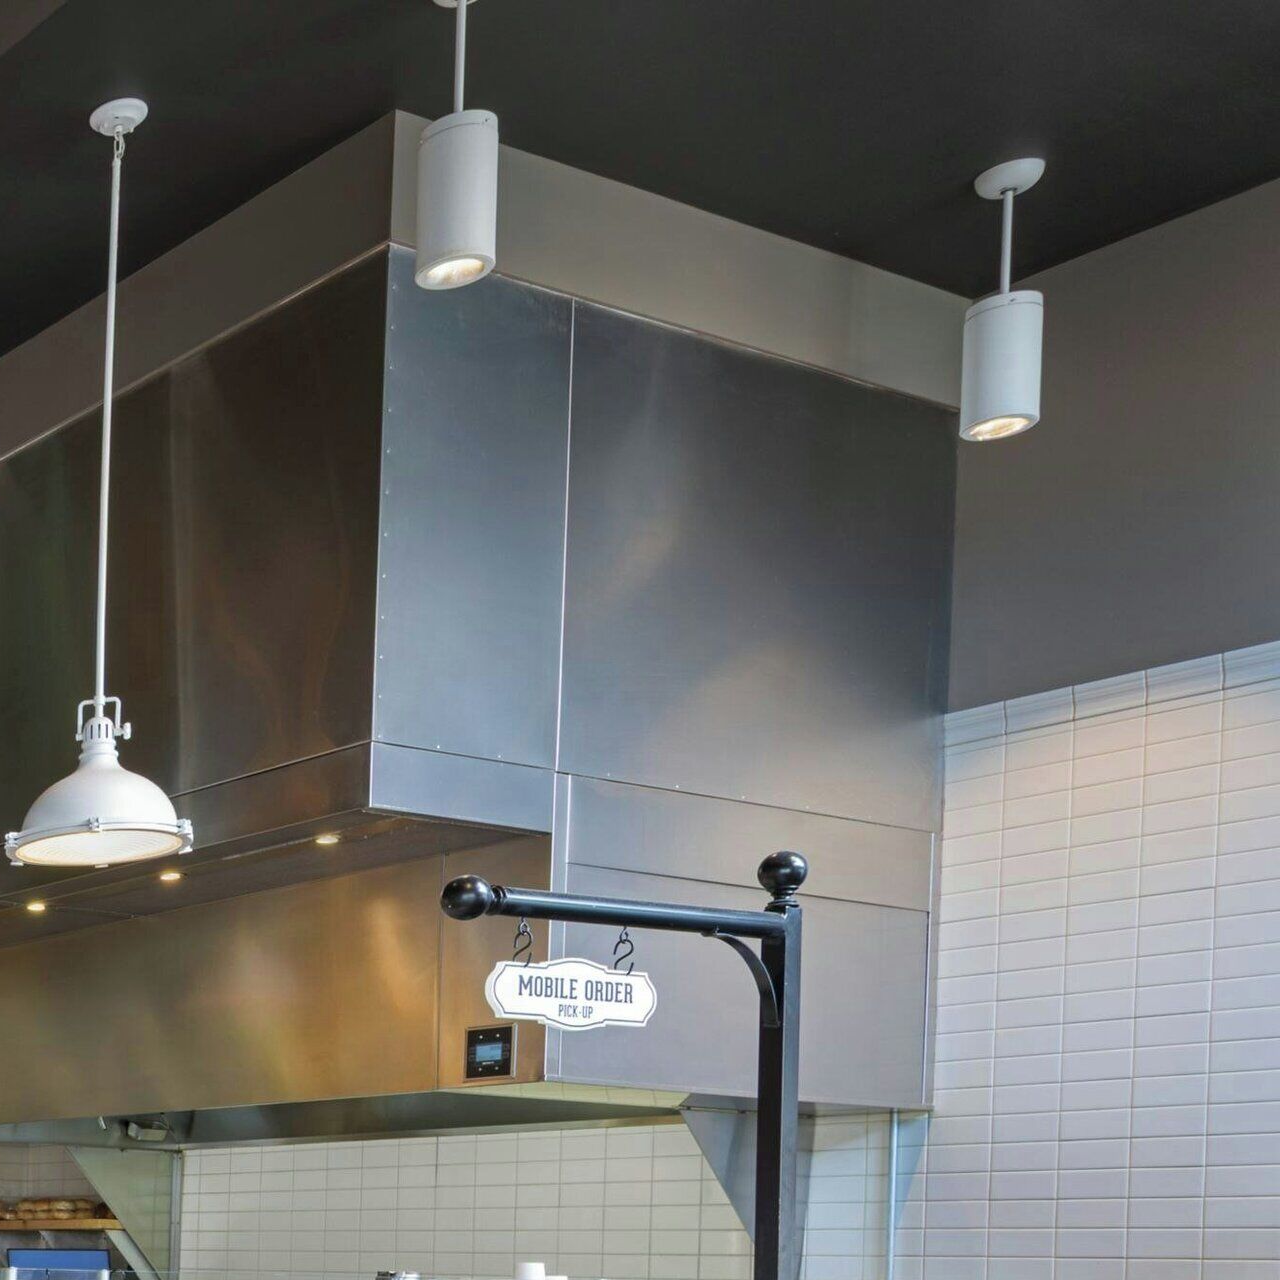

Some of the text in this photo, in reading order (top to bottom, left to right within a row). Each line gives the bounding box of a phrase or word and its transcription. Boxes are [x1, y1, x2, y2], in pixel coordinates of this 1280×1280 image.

[518, 975, 633, 1003] MOBILE ORDER
[558, 1004, 593, 1018] PICK-UP
